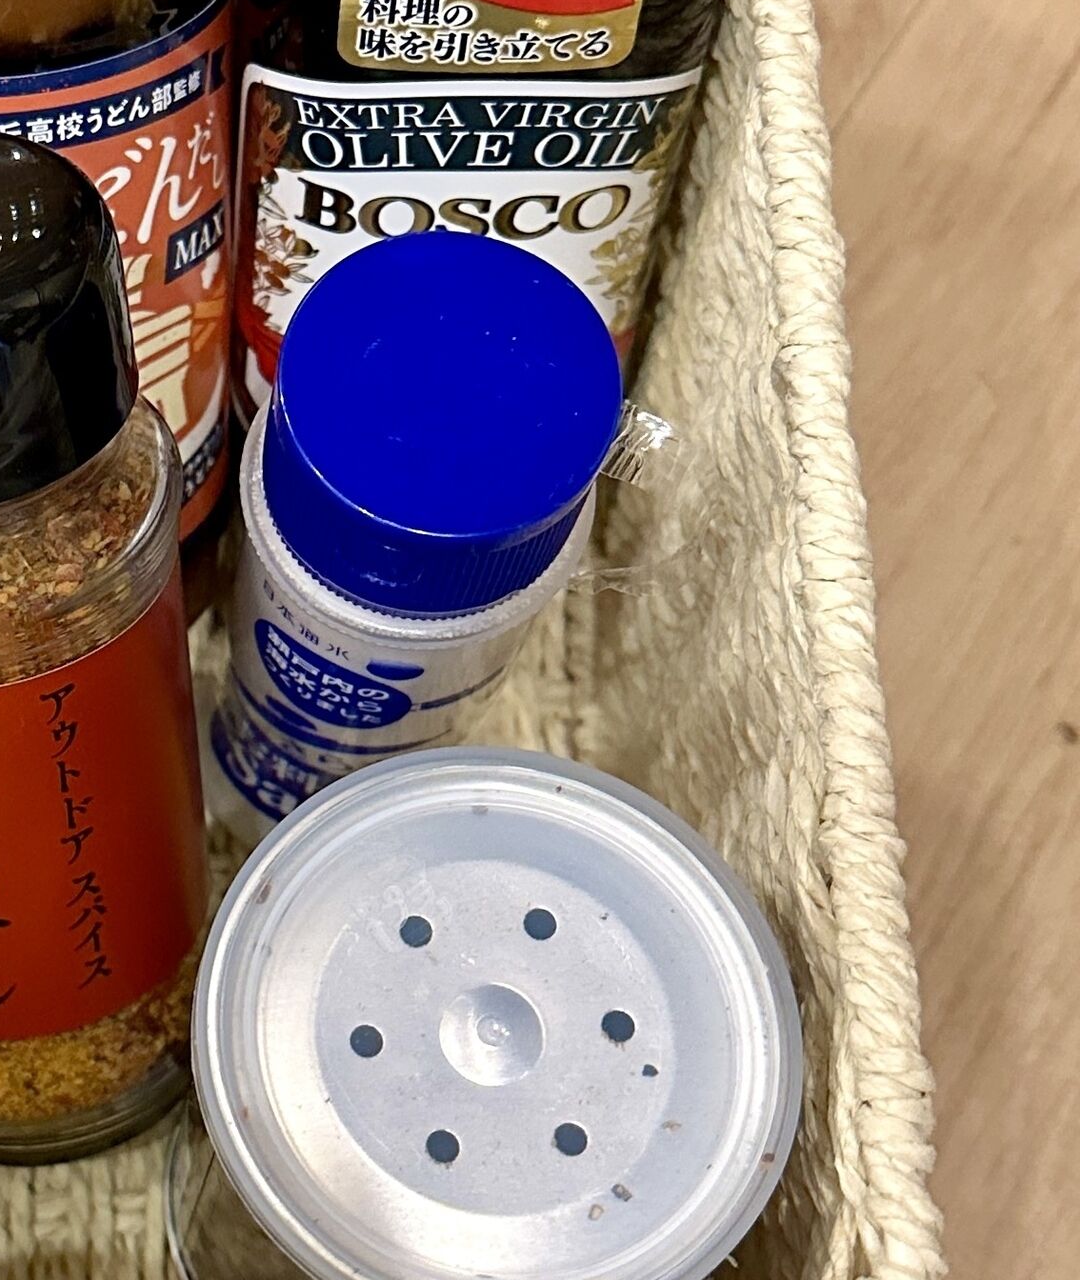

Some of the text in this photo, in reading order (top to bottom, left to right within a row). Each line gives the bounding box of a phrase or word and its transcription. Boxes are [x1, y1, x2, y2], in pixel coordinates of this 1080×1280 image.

[358, 28, 611, 64] 味を引き立てる
[292, 96, 666, 130] EXTRA VIRGIN
[301, 128, 645, 169] OLIVE OIL
[294, 176, 632, 241] BOSCO
